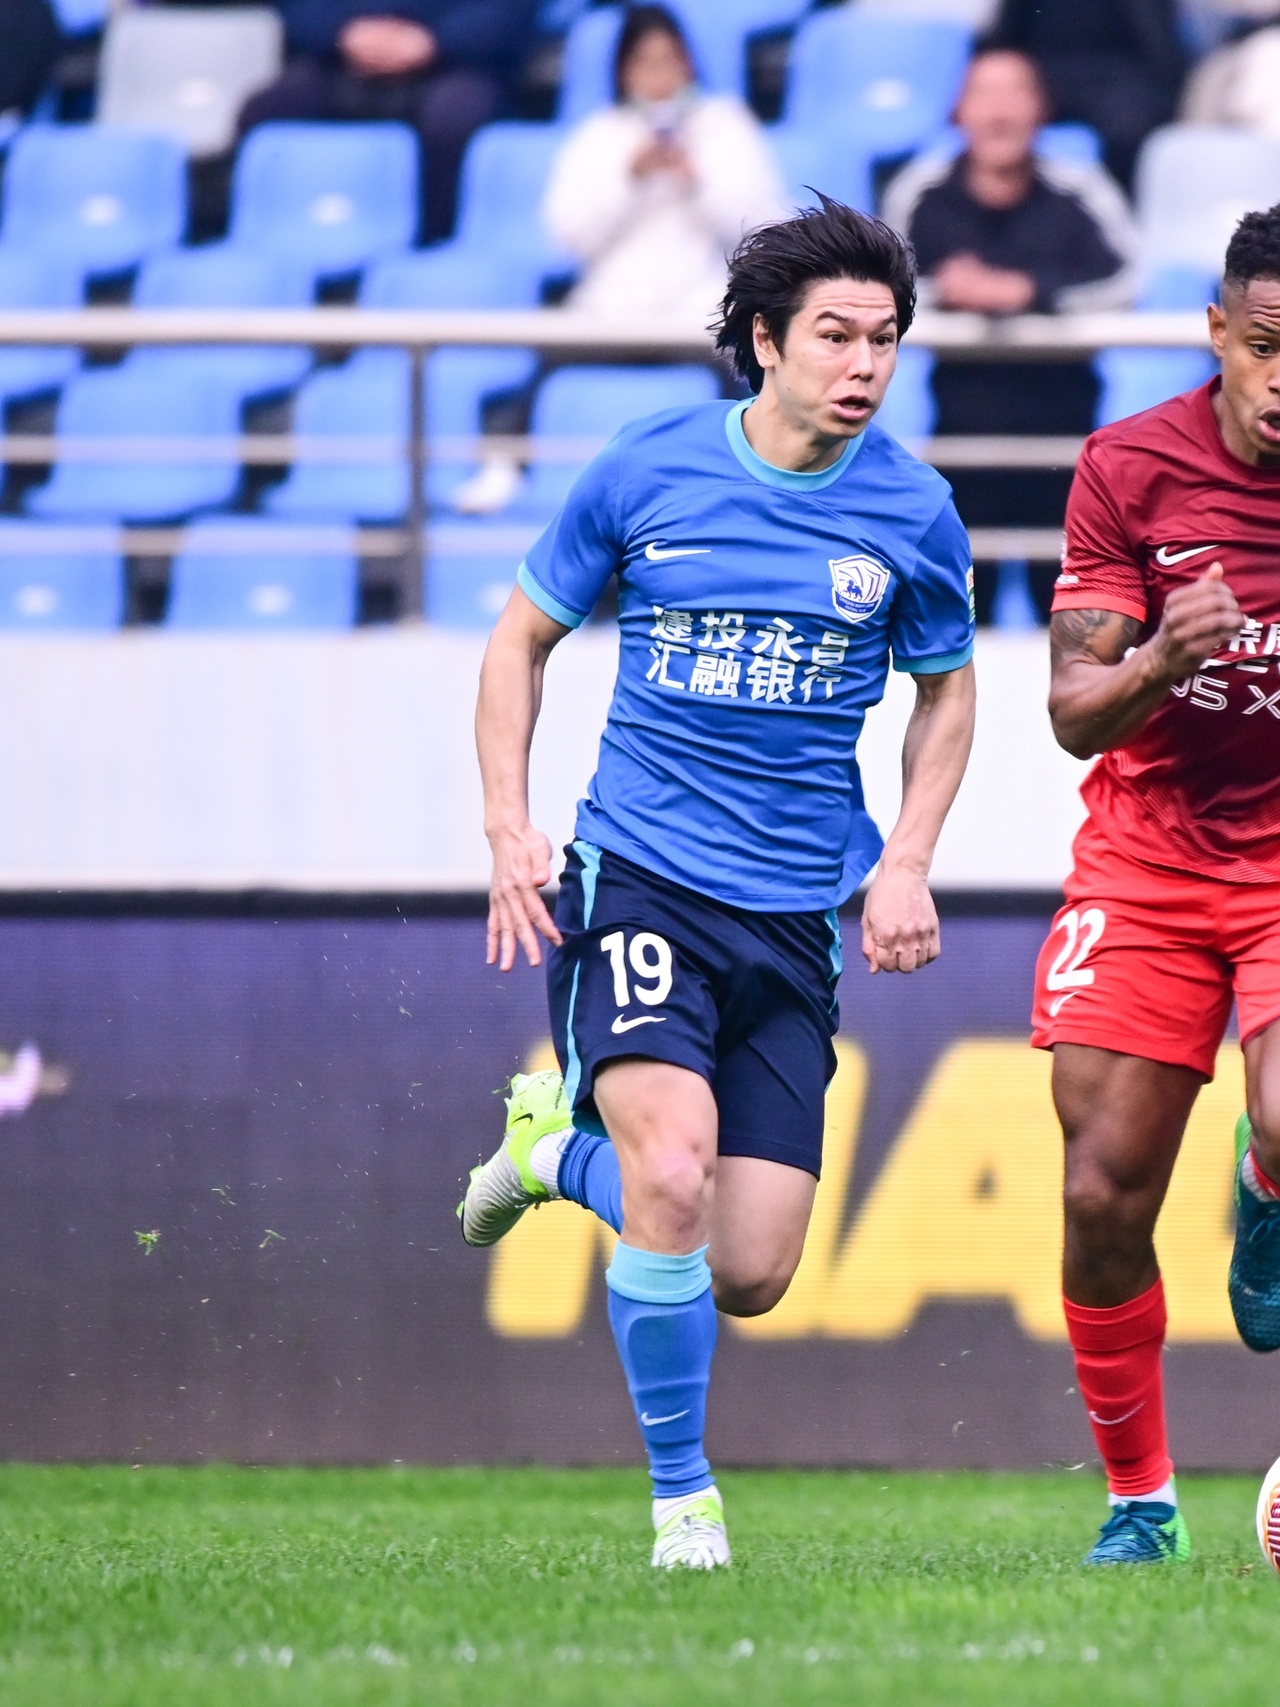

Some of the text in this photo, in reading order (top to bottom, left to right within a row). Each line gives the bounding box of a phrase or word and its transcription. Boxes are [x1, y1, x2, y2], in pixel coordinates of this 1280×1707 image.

[645, 641, 843, 704] 汇融银行
[600, 931, 673, 1007] 19
[1046, 908, 1106, 991] 22
